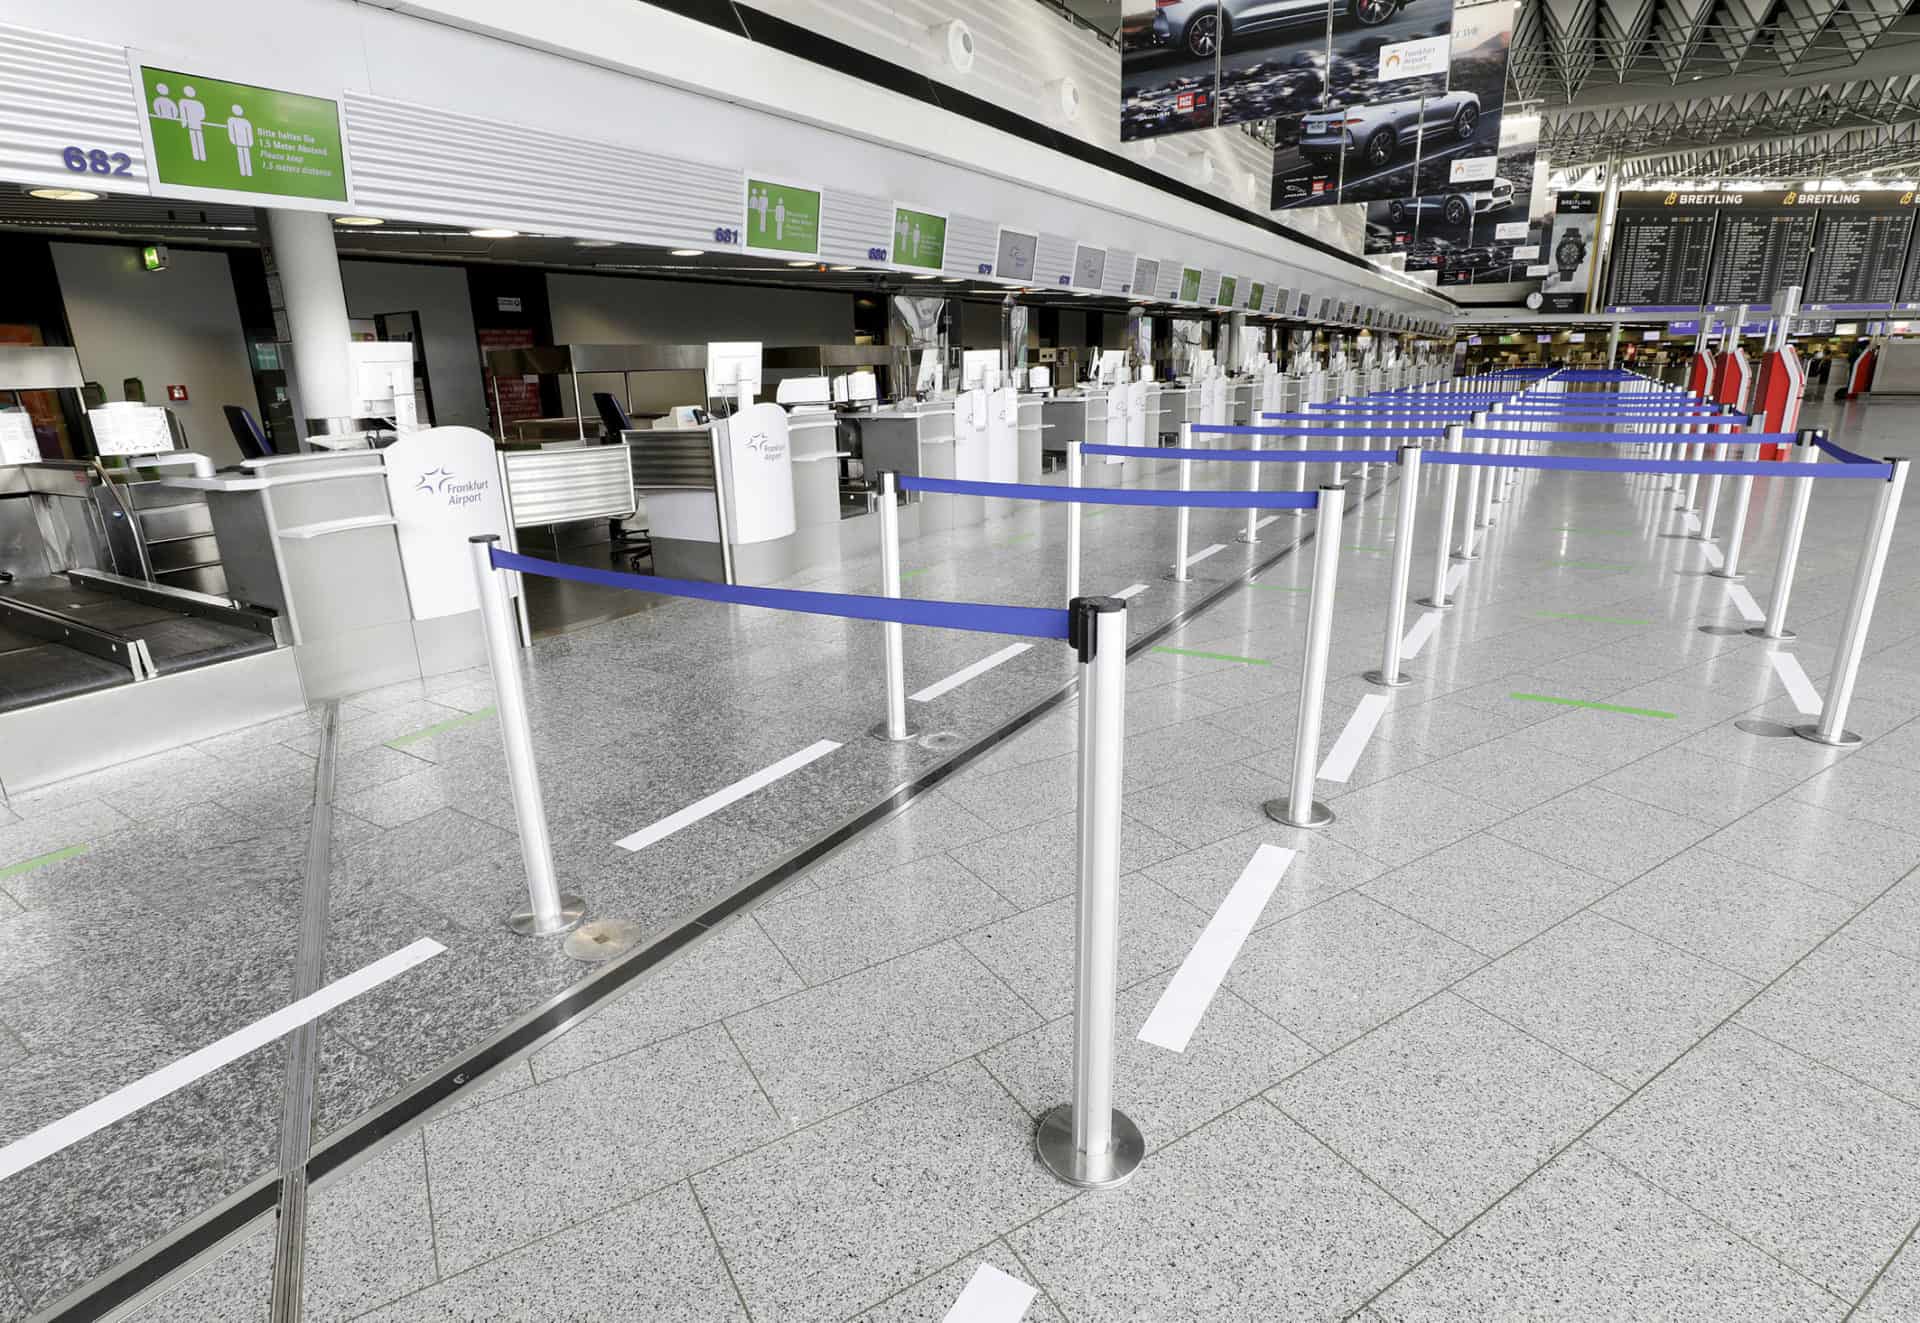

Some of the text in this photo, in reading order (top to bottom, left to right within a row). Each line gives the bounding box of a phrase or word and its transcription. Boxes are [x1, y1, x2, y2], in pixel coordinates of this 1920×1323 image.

[63, 146, 133, 176] 682
[1680, 194, 1743, 204] BREITLING
[1798, 194, 1860, 204] BREITLING
[714, 227, 738, 244] 681
[868, 248, 888, 261] 680
[447, 480, 488, 494] Frankfurt
[448, 493, 481, 508] Airport
